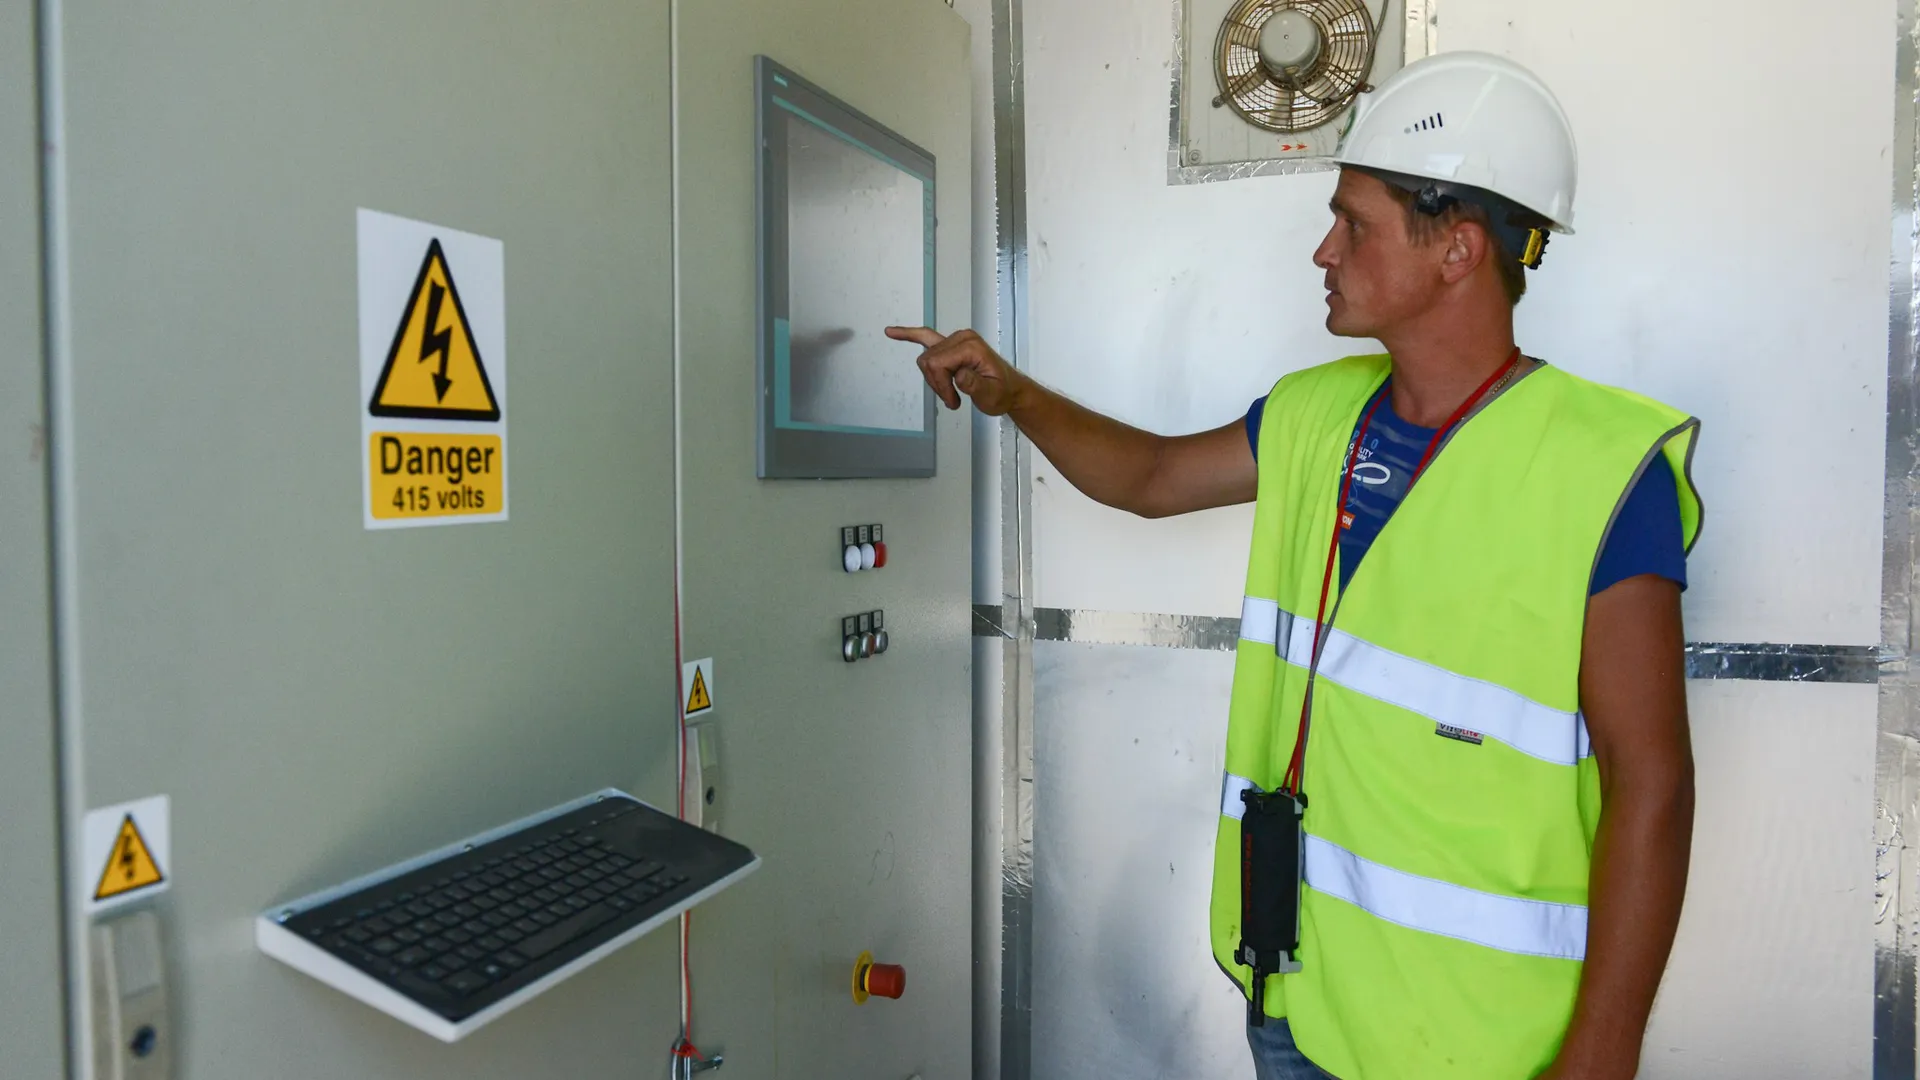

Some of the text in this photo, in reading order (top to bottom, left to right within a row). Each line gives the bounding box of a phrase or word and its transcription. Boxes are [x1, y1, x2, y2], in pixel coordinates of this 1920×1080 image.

[380, 436, 494, 484] Danger
[392, 484, 484, 511] 415 volts
